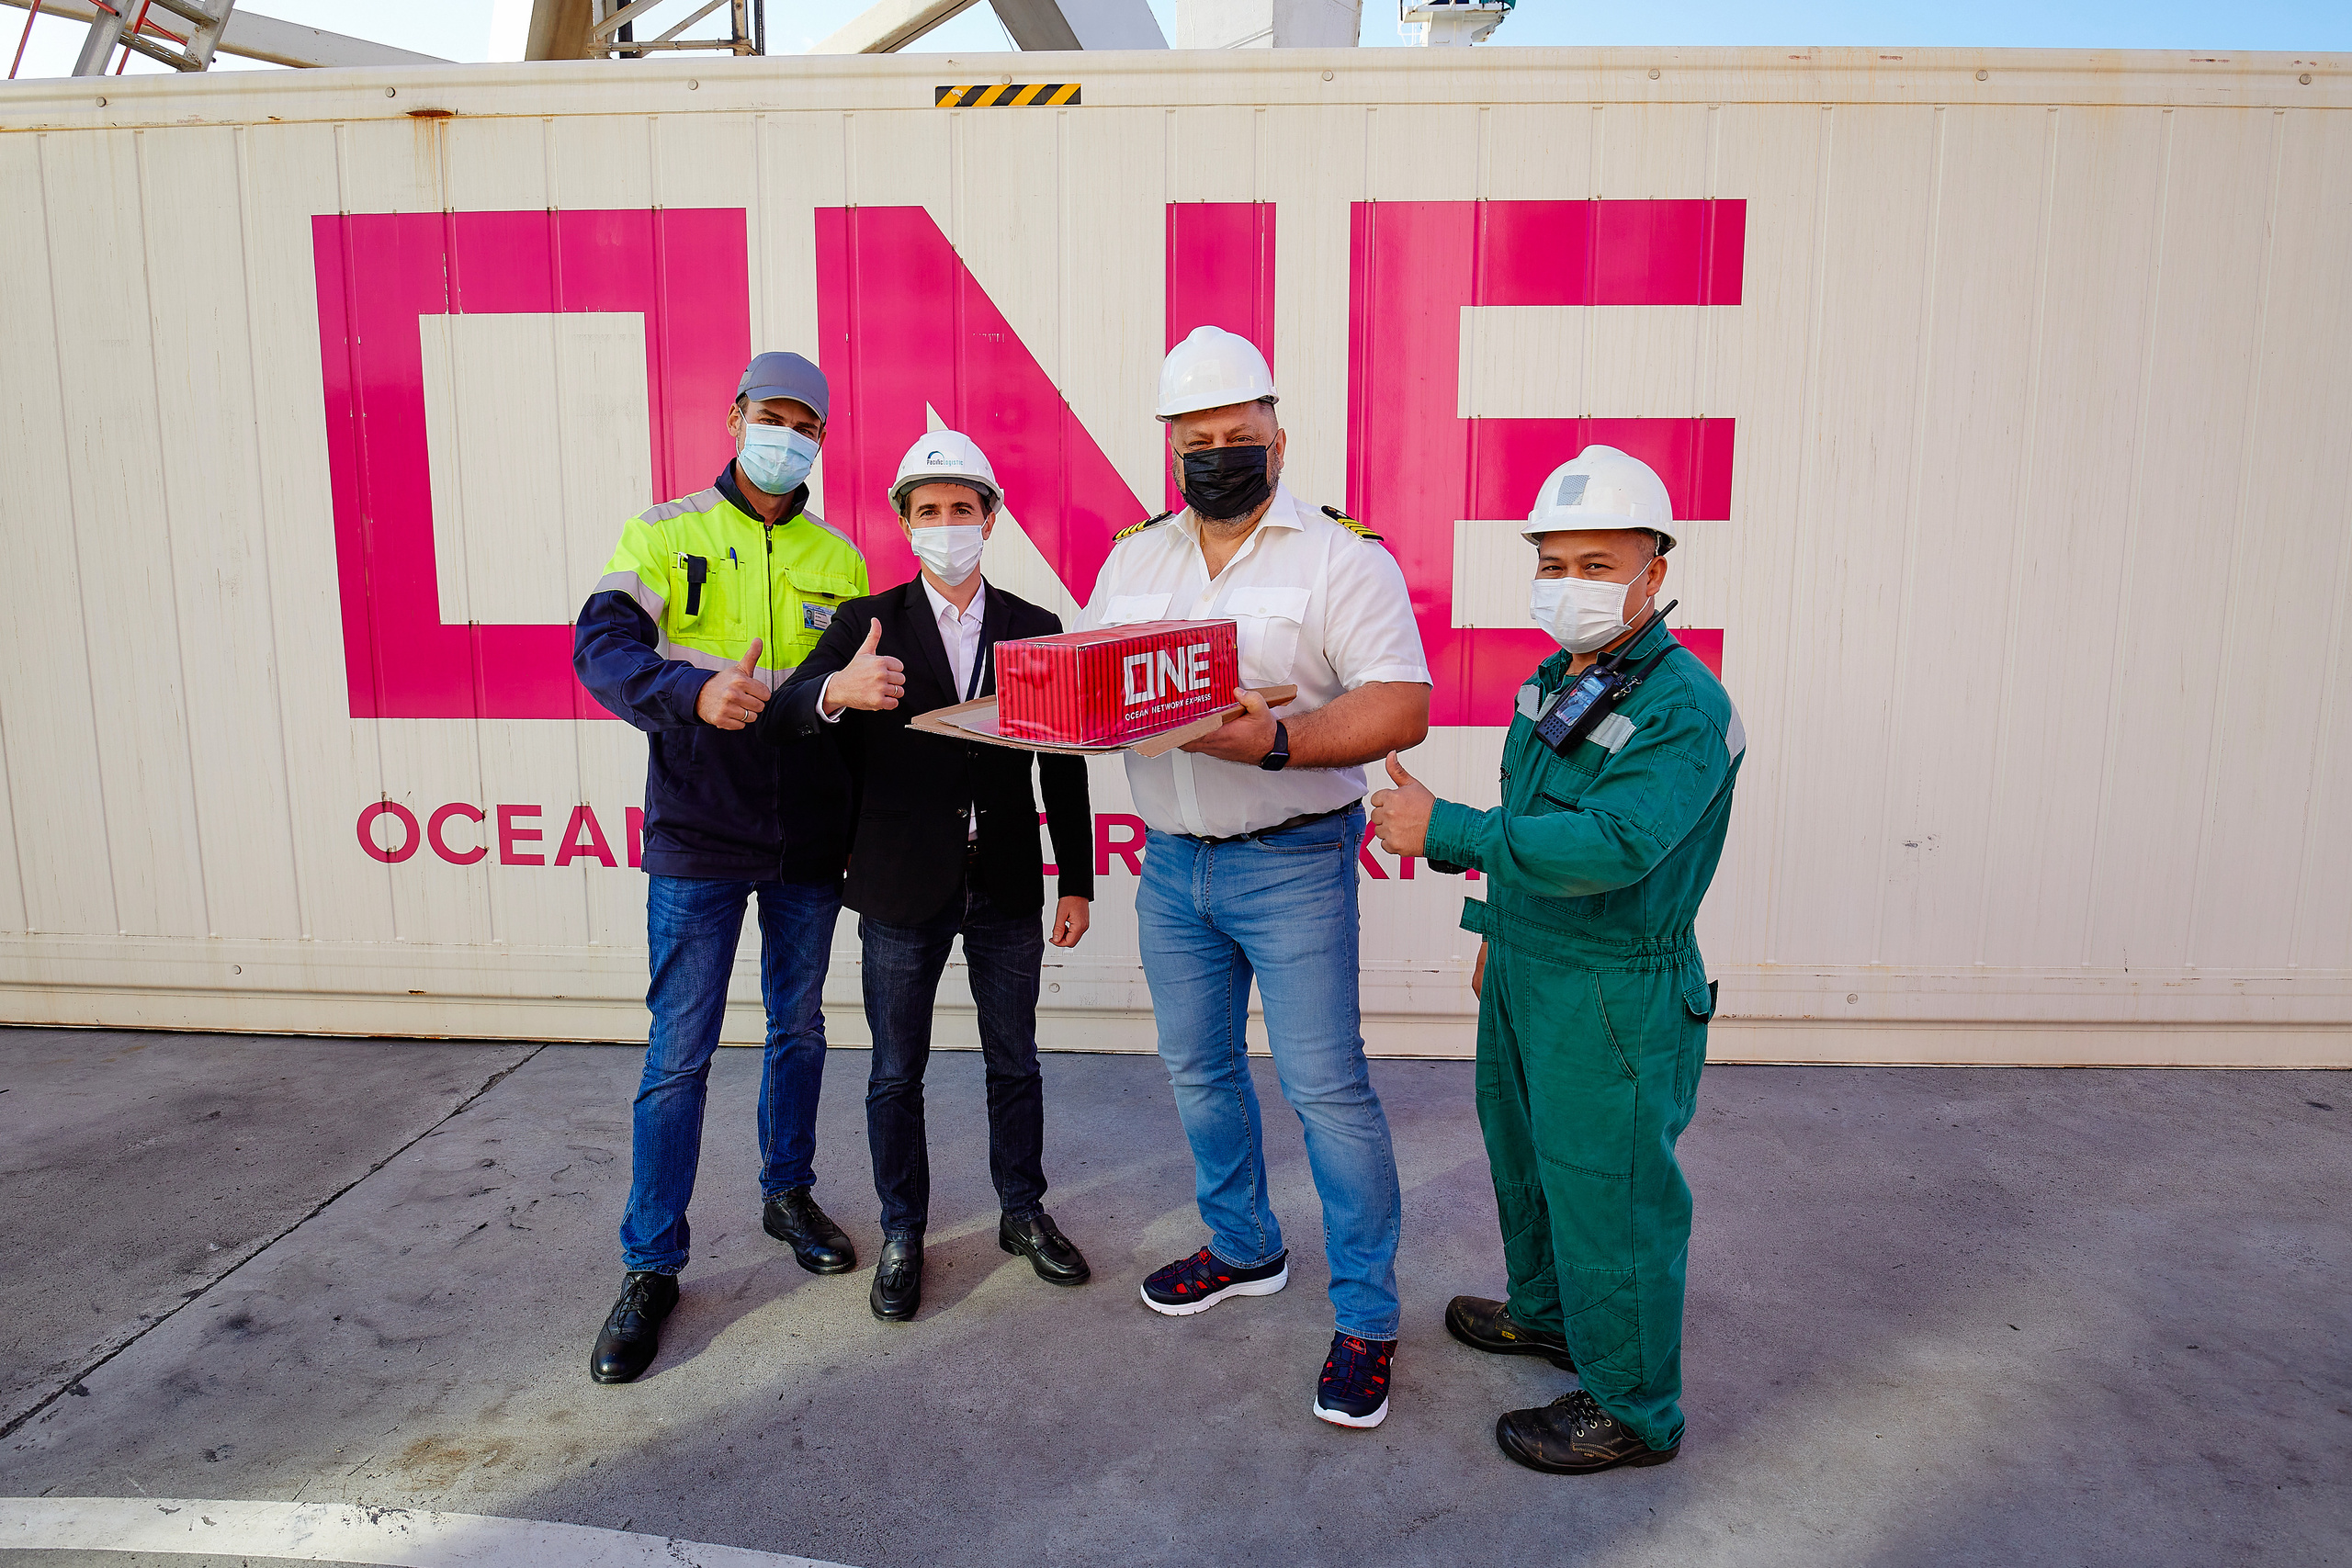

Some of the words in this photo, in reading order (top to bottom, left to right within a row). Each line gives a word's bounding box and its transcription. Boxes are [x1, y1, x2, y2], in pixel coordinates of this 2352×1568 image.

[311, 198, 1747, 727] ONE
[1124, 642, 1210, 705] ONE
[1125, 708, 1149, 721] OCEAN
[1185, 693, 1212, 705] EXPRESS
